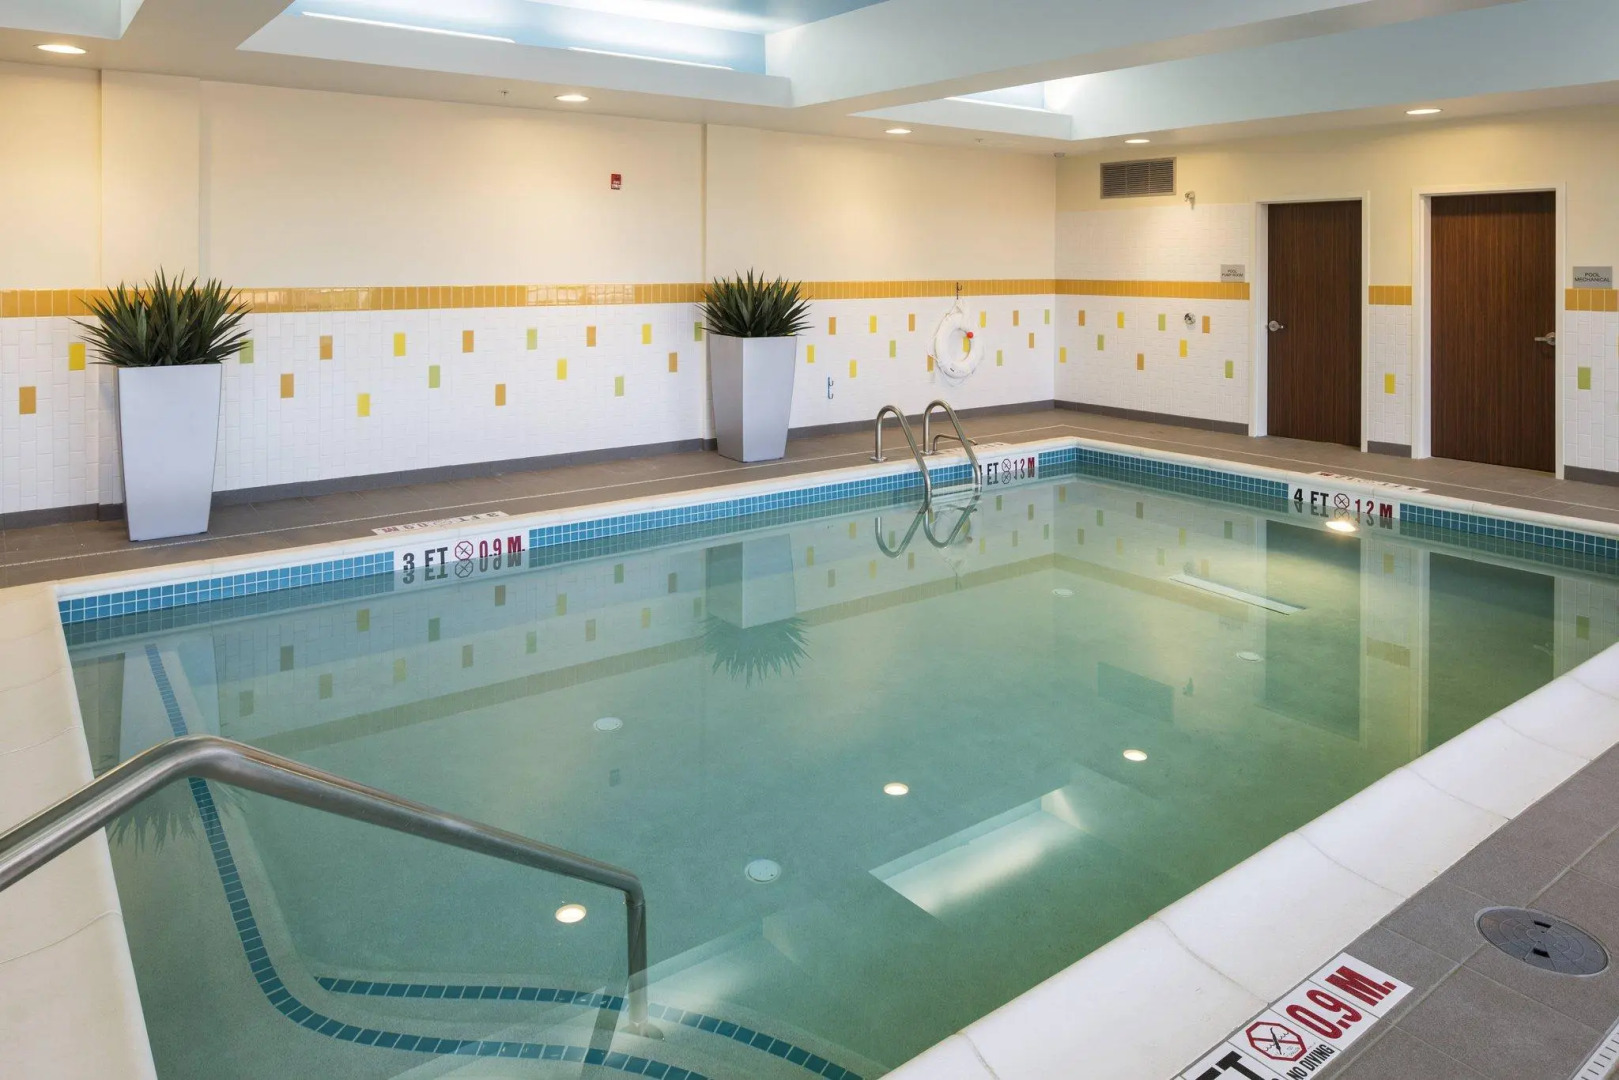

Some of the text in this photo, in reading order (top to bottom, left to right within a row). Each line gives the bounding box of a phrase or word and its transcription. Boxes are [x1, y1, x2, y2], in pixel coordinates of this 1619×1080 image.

[1293, 488, 1304, 502] 4
[1310, 491, 1329, 506] FT
[403, 552, 415, 570] 3
[424, 546, 449, 567] FT
[479, 538, 501, 558] 0.9
[1285, 989, 1363, 1040] 0.9
[1324, 965, 1397, 1007] M.
[1286, 1043, 1336, 1080] NO DIVING
